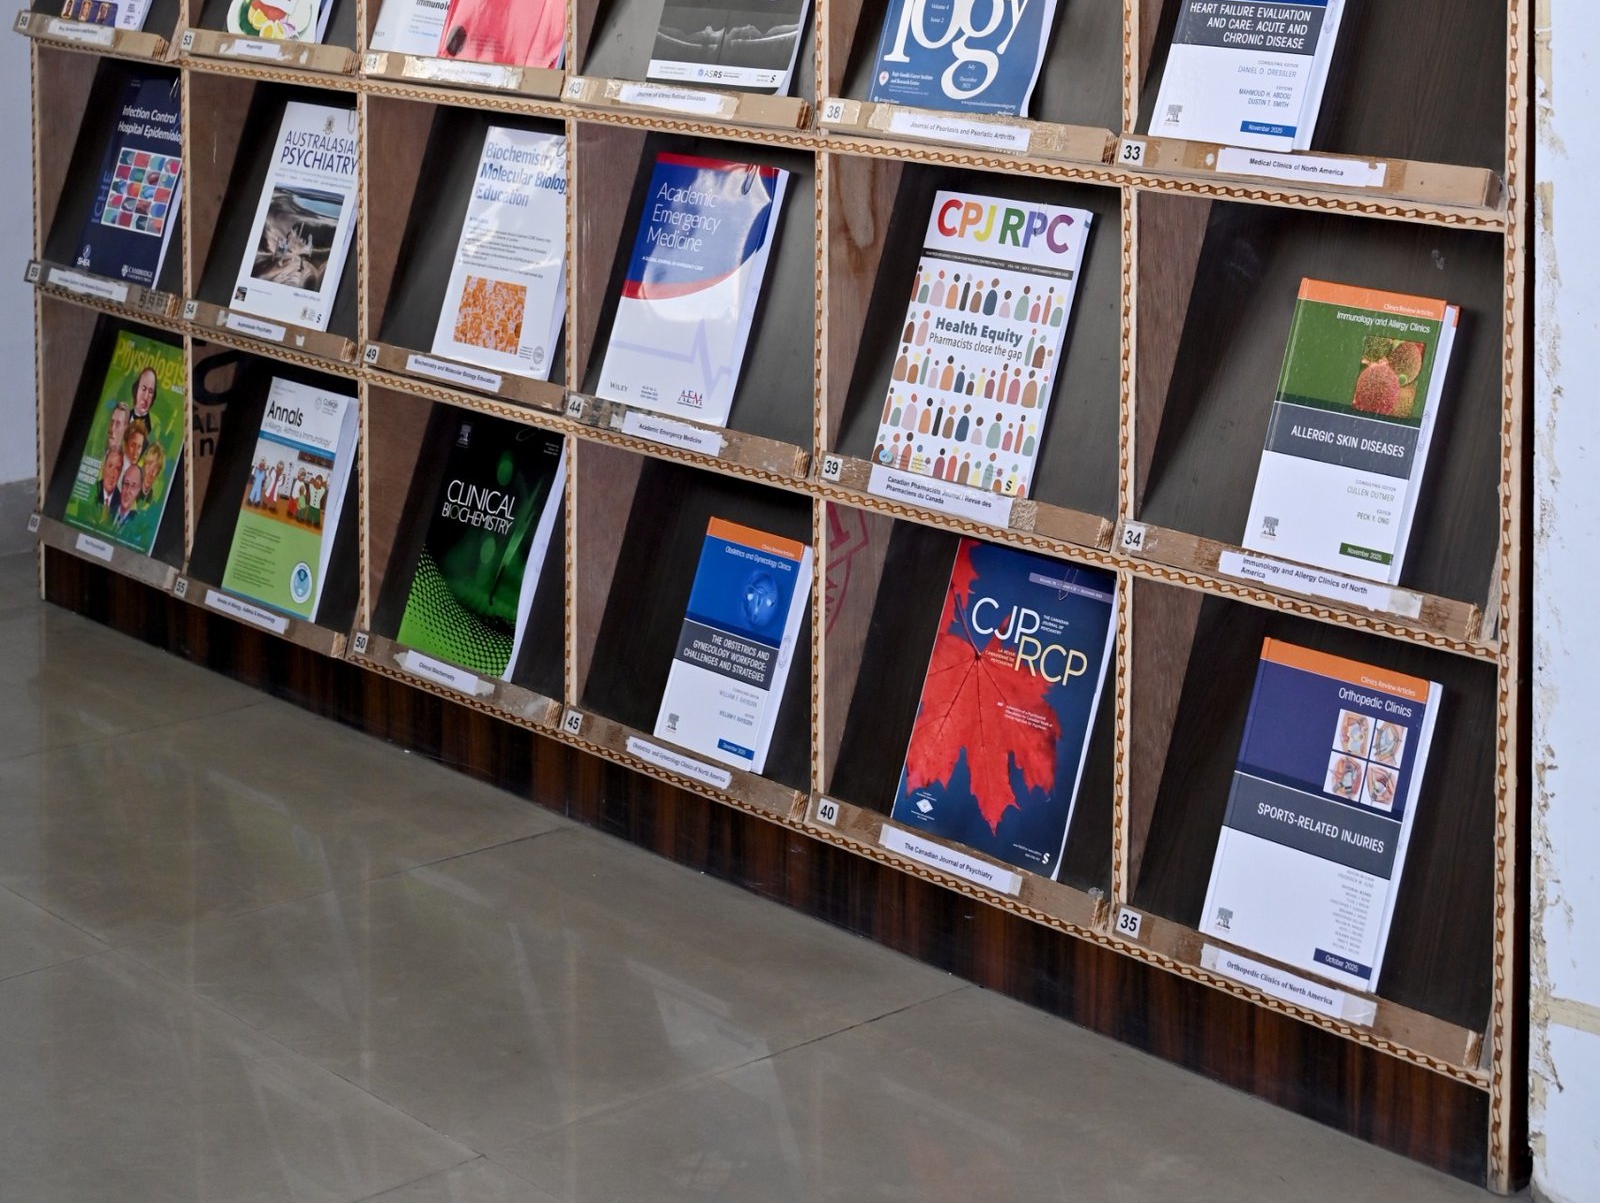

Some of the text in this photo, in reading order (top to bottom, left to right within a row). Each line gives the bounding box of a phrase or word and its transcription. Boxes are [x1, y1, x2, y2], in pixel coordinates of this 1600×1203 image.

[1190, 2, 1312, 21] HEART FAILURE EVALUATION
[1207, 16, 1308, 36] AND CARE: ACUTE AND
[183, 34, 192, 46] 53
[1223, 32, 1305, 49] CHRONIC DISEASE
[122, 104, 178, 124] Infection Control
[826, 105, 840, 119] 38
[118, 120, 144, 136] Hospital
[280, 146, 358, 176] PSYCHIATRY
[486, 142, 555, 170] Biochemistry
[1124, 144, 1140, 161] 33
[480, 162, 566, 196] Molecular Biolog
[1250, 158, 1272, 168] Medical
[1272, 159, 1294, 169] Clinics
[1300, 164, 1318, 174] North
[1318, 166, 1344, 176] America
[476, 182, 530, 207] Education
[656, 182, 718, 208] Academic
[652, 204, 722, 235] Emergency
[937, 198, 1074, 254] CPJ RPC
[646, 226, 702, 252] Medicine
[935, 316, 1024, 348] Health Equity
[1336, 310, 1431, 334] Immunology and Allergy Clinics
[366, 348, 377, 360] 49
[929, 332, 1022, 362] Pharmacists close the gap
[266, 400, 304, 427] Annals
[569, 400, 581, 413] 44
[1291, 424, 1405, 458] ALLERGIC SKIN DISEASES
[824, 460, 840, 476] 39
[447, 479, 516, 520] CLINICAL
[442, 502, 513, 536] BIOCHEMISTRY
[1124, 530, 1141, 547] 34
[1240, 566, 1266, 579] America
[1242, 557, 1368, 594] Immunology and Allergy Clinics of North
[176, 581, 186, 594] 55
[972, 597, 1040, 644] CJP
[356, 636, 366, 649] 50
[712, 634, 770, 661] THE OBSTETRICS AND
[684, 648, 764, 683] CHALLENGES AND STRATEGIES
[693, 640, 767, 672] GYNECOLOGY WORKFORCE:
[1014, 635, 1088, 686] RCP
[1338, 687, 1412, 718] Orthopedic Clinics
[568, 717, 580, 730] 45
[820, 804, 834, 820] 40
[1257, 802, 1385, 854] SPORTS-RELATED INJURIES
[904, 842, 993, 881] The Canadian Journal of Psychiatry
[1120, 913, 1138, 932] 35
[1226, 960, 1333, 1006] Orthopedic Clinics of North America
